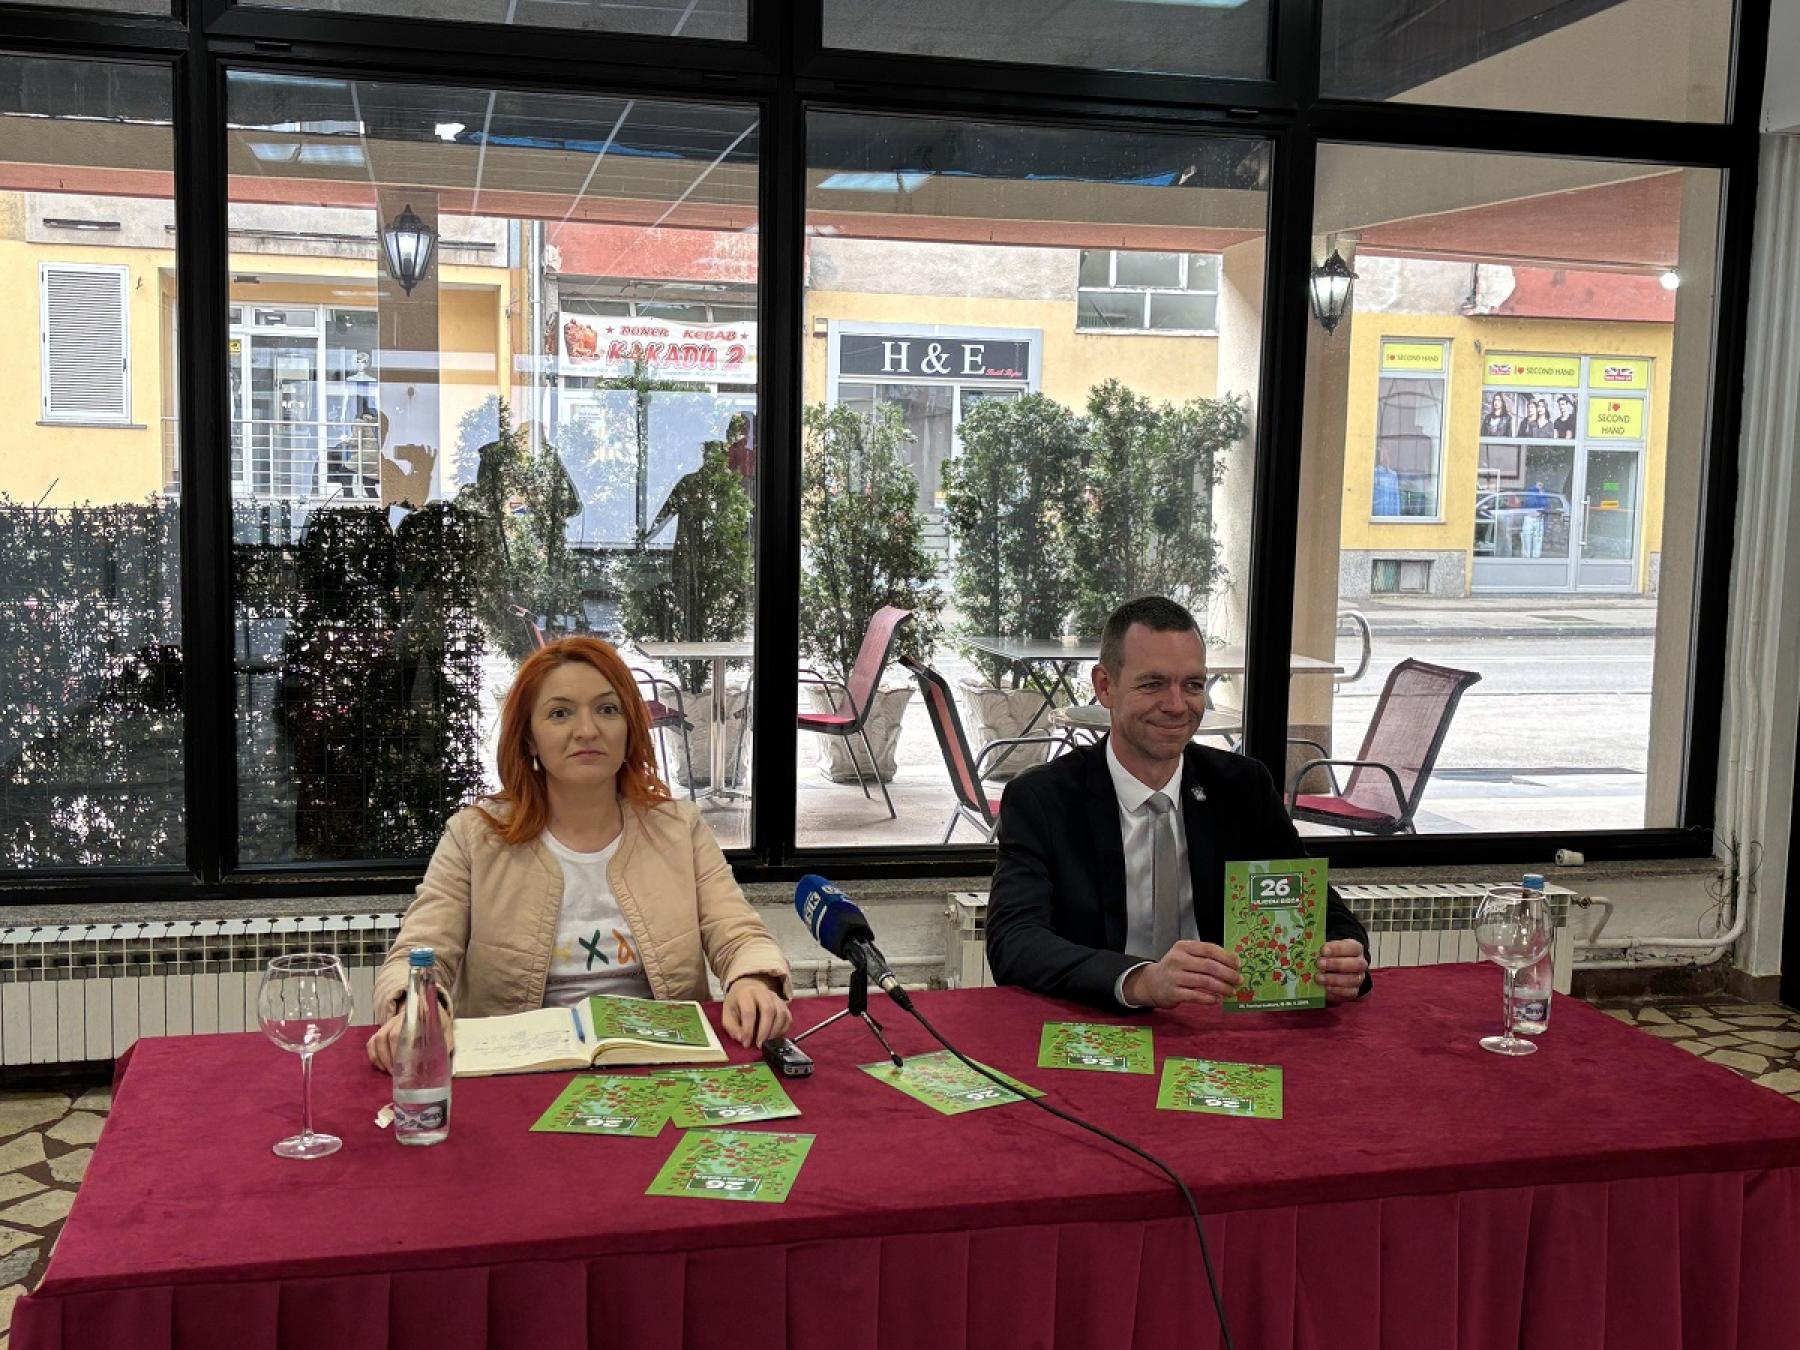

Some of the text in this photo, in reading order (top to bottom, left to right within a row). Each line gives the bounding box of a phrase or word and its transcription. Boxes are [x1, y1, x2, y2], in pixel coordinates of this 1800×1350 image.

[722, 343, 746, 370] 2
[881, 341, 986, 375] H & E
[1526, 367, 1554, 376] SECOND
[1555, 368, 1575, 376] HAND
[1597, 413, 1630, 424] SECOND
[1601, 425, 1625, 435] HAND
[1260, 878, 1290, 897] 26
